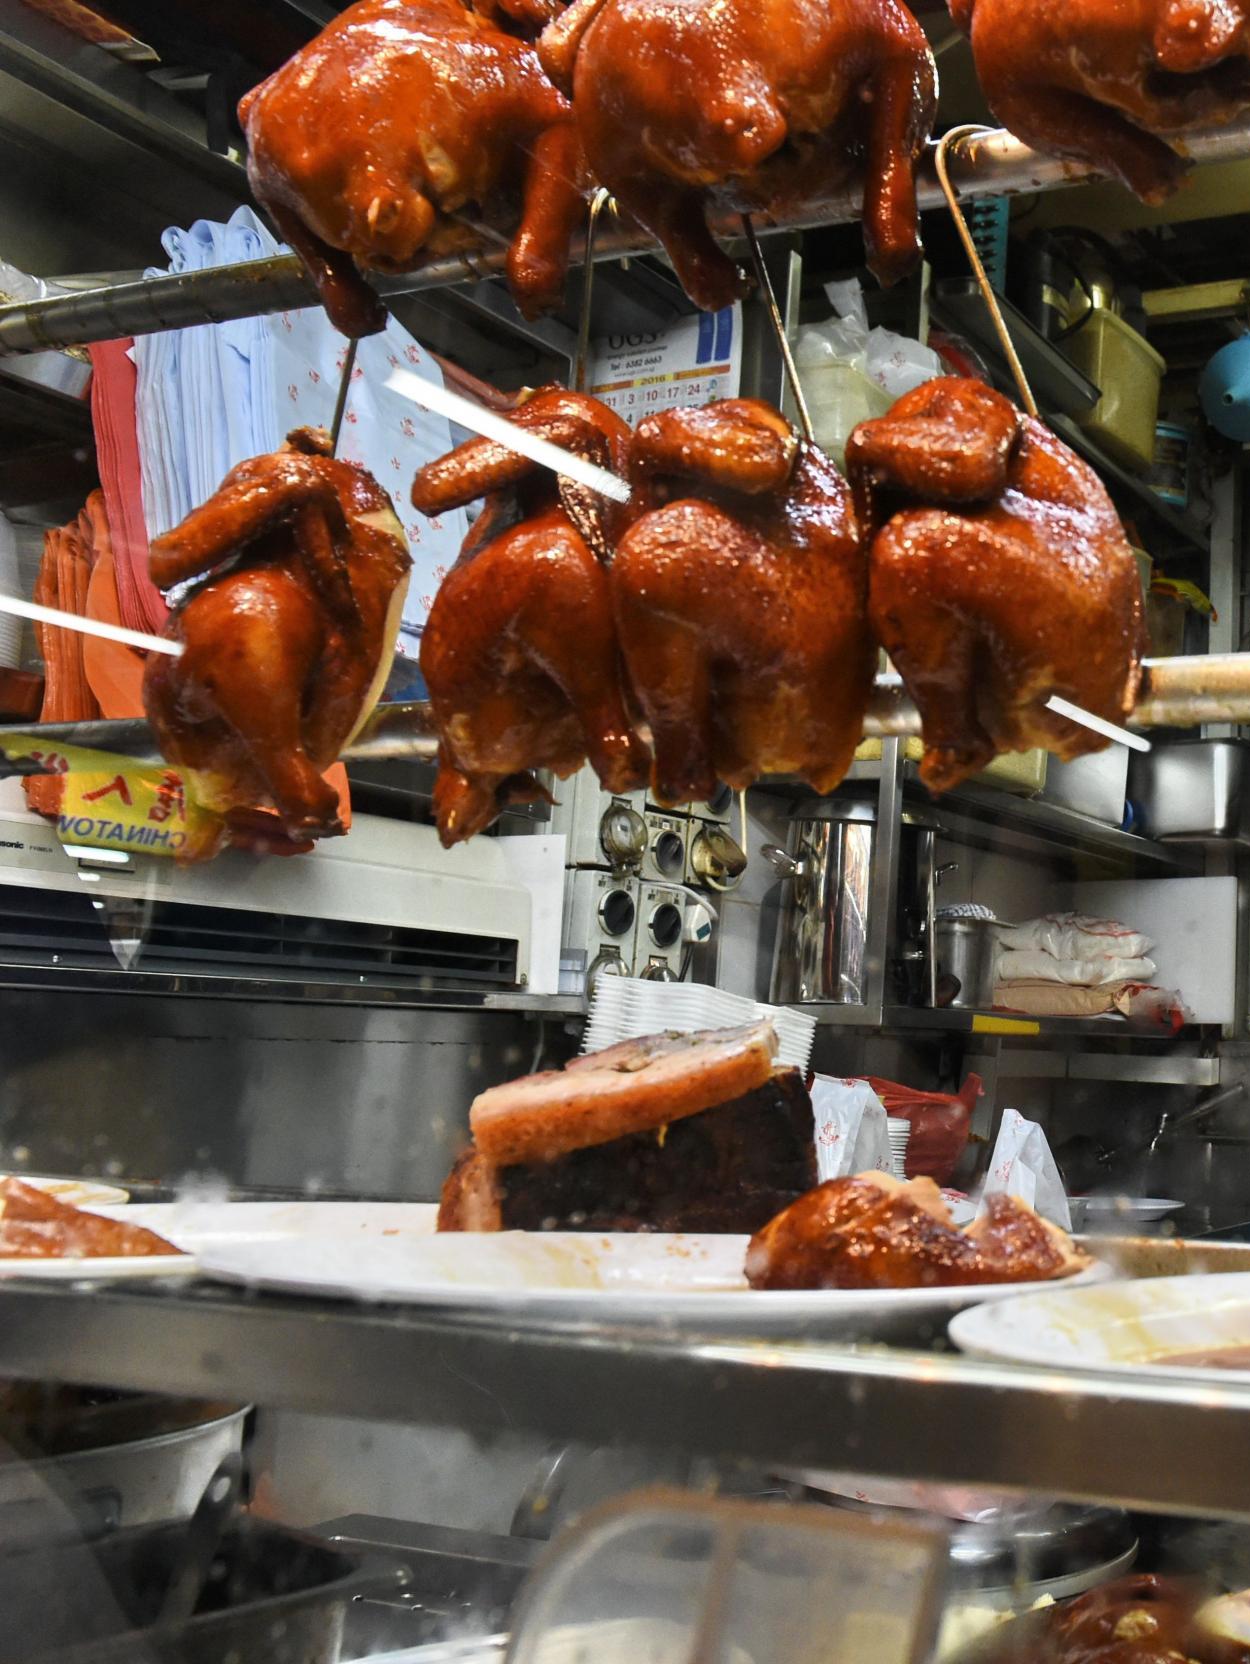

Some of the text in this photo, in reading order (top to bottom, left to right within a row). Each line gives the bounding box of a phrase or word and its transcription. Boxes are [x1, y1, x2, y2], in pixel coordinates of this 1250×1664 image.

[640, 376, 666, 386] 2016
[628, 393, 635, 404] 3
[646, 390, 658, 401] 10
[667, 387, 679, 398] 17
[687, 384, 700, 396] 24
[626, 413, 632, 424] 4
